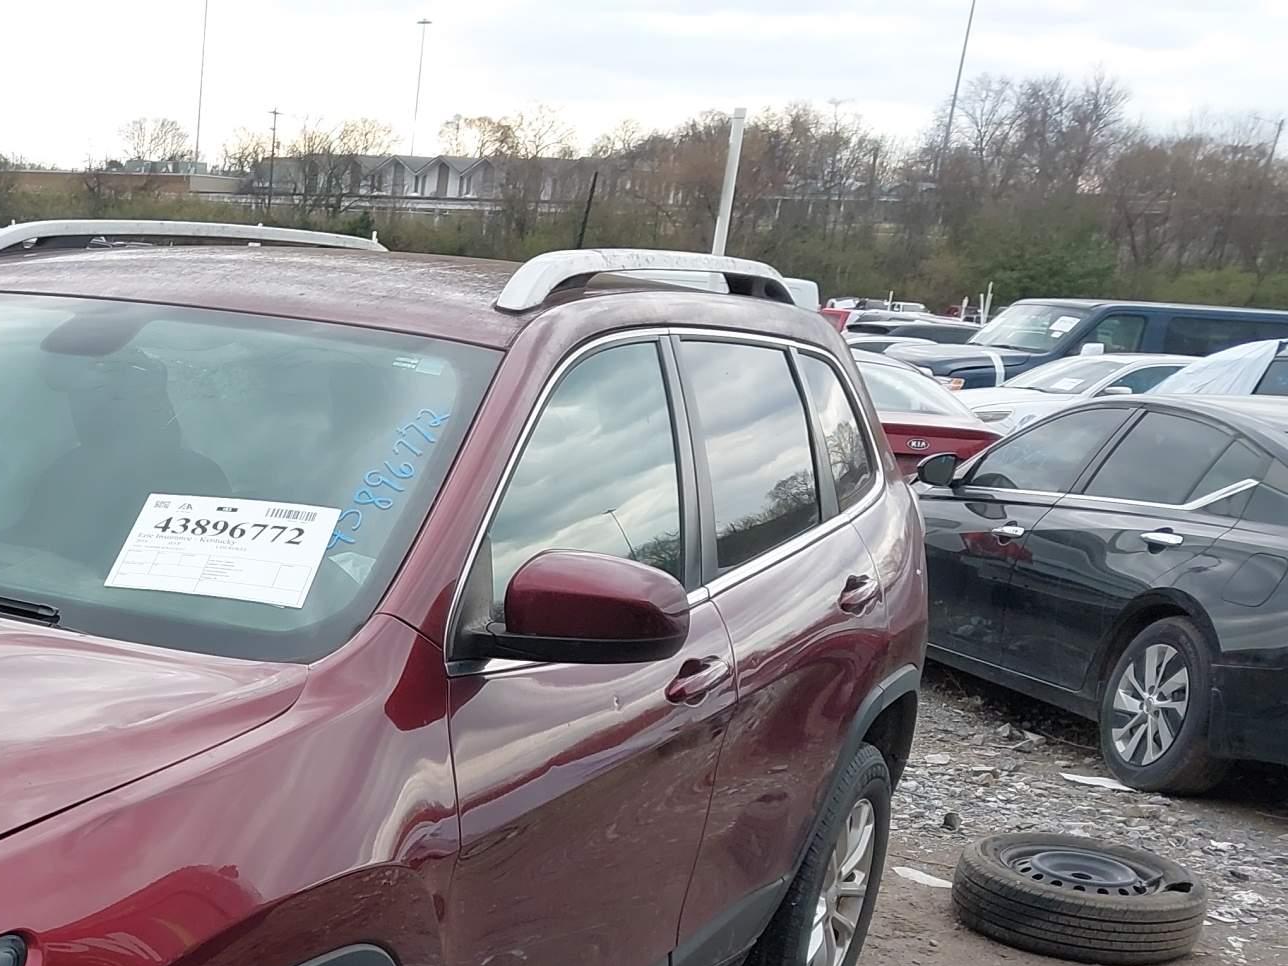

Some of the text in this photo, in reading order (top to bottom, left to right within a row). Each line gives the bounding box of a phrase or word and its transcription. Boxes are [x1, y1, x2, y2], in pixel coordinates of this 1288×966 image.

[911, 440, 927, 448] KIA
[154, 515, 306, 546] 43896772
[199, 536, 239, 546] Kentucky
